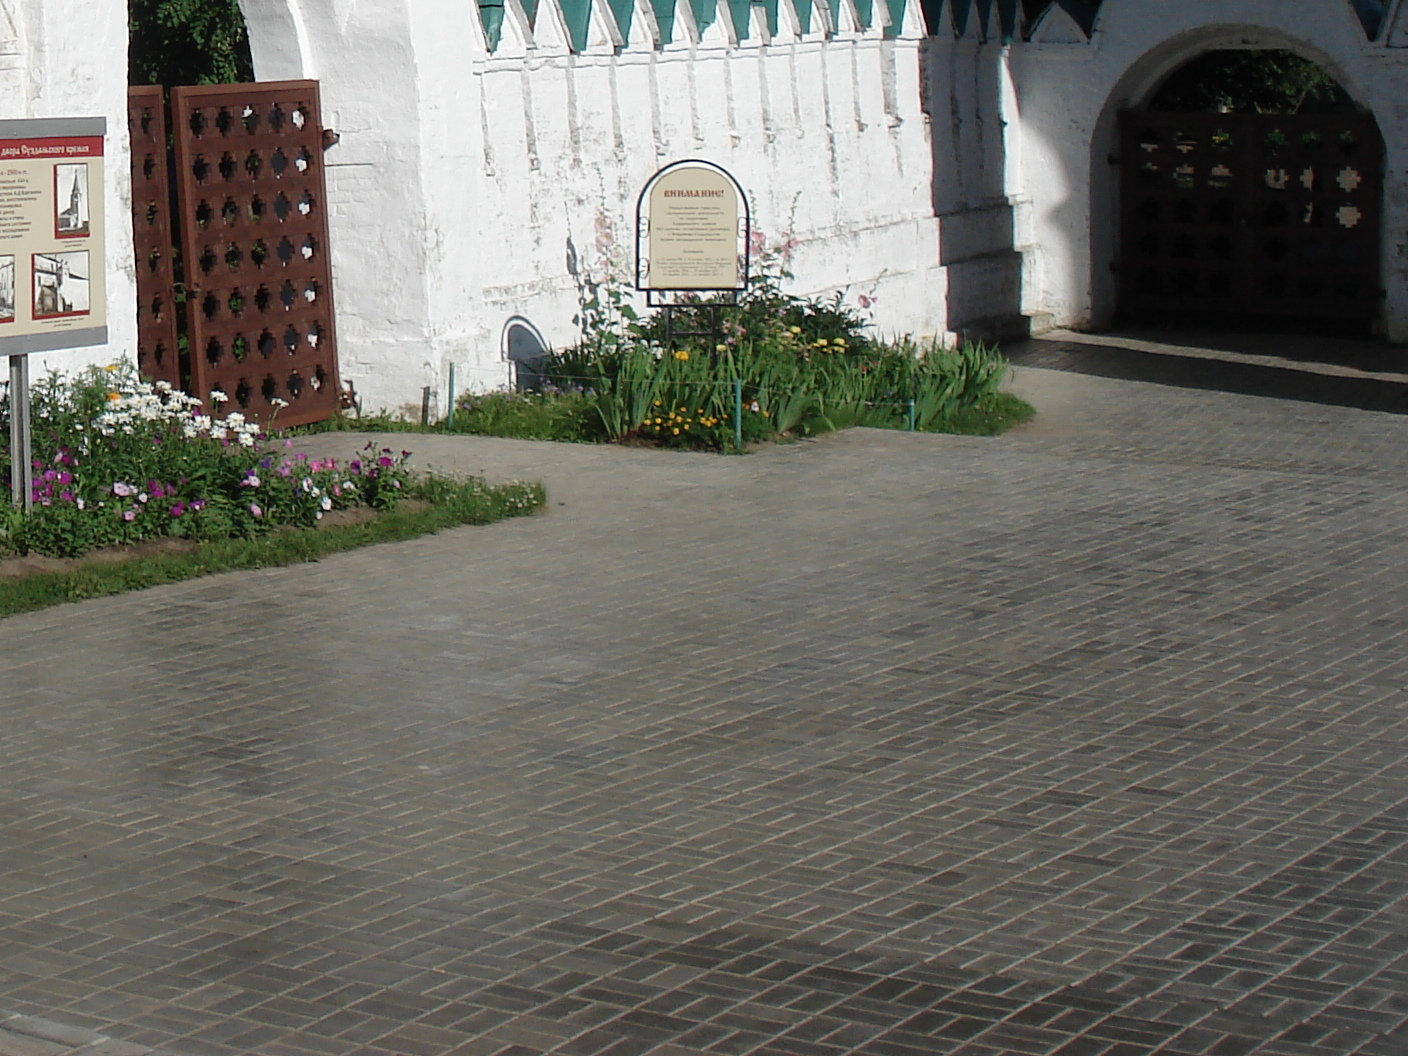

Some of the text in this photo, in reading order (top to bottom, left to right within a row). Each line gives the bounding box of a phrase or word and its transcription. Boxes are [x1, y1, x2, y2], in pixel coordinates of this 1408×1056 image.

[1, 146, 20, 157] двора
[21, 144, 65, 157] Суздальского
[66, 145, 90, 156] кремля
[663, 189, 725, 198] ВНИМАНИЕ!
